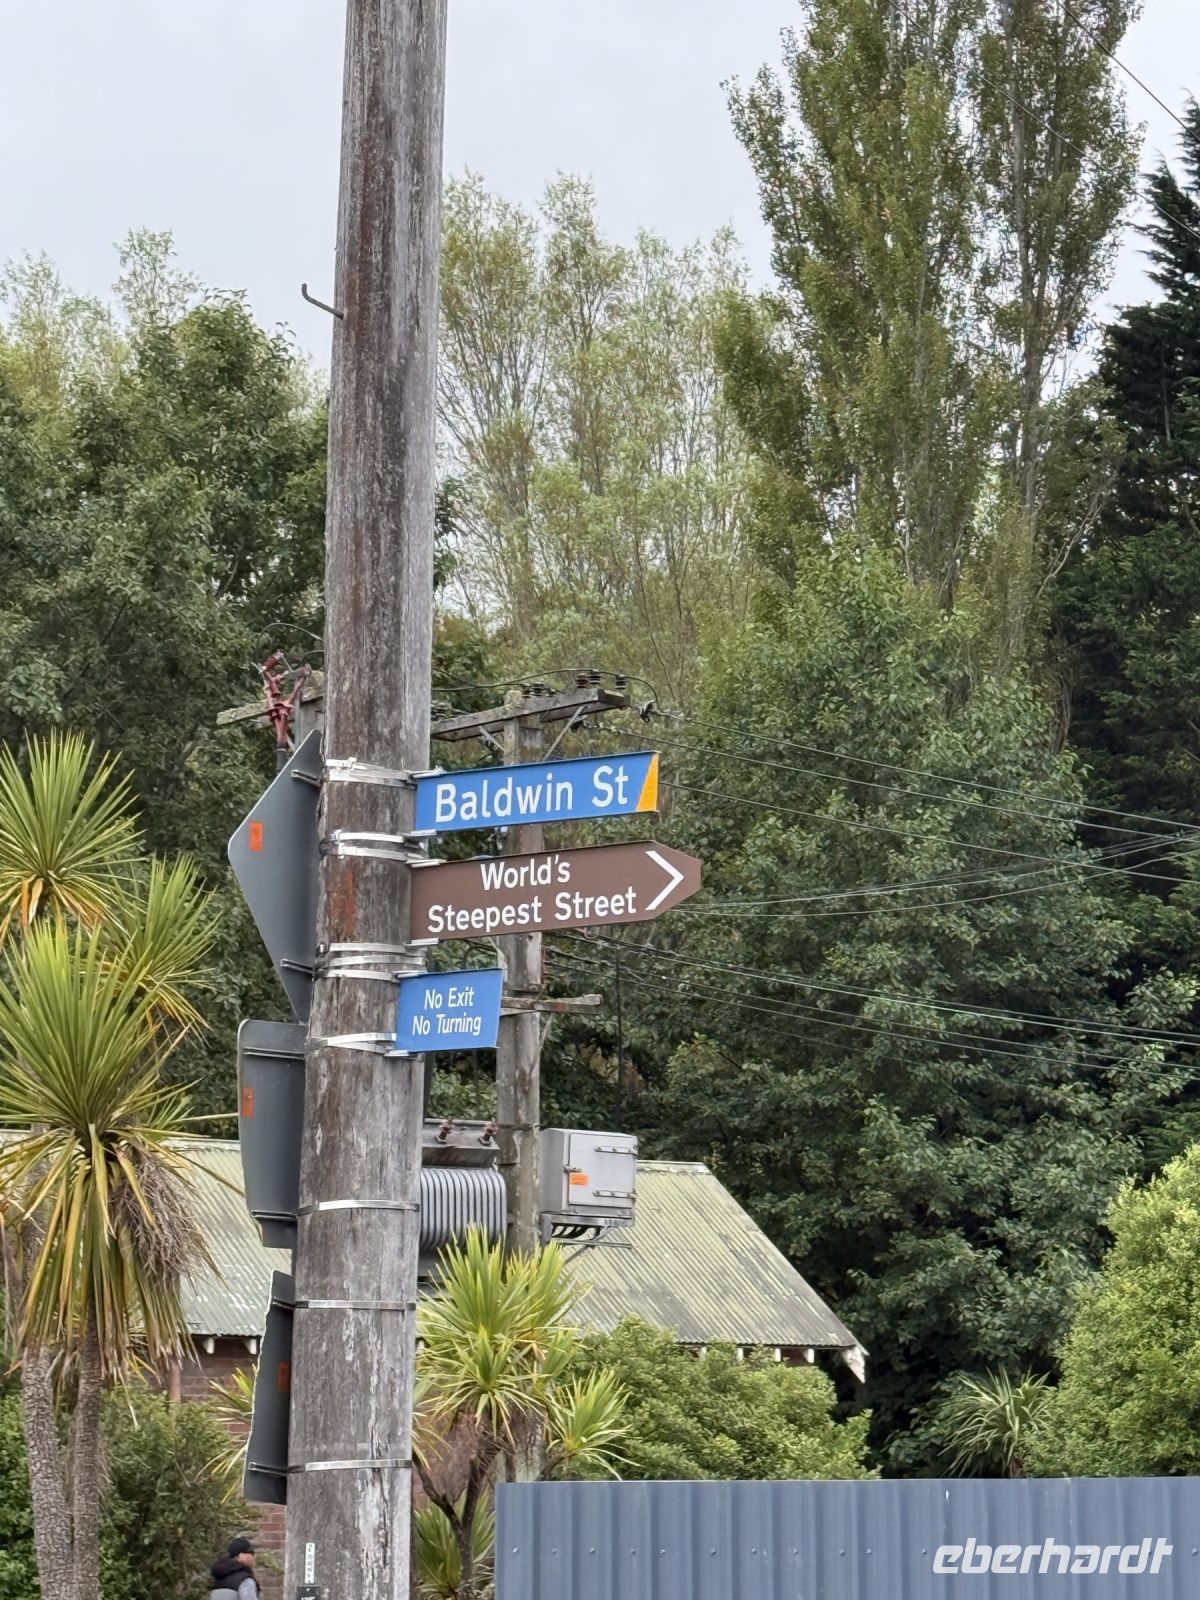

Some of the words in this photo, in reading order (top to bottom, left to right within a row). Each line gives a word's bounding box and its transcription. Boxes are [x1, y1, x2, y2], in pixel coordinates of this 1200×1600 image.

[435, 772, 573, 823] Baldwin
[592, 765, 629, 808] St
[480, 854, 571, 891] World's
[427, 895, 542, 932] Steepest
[554, 886, 637, 921] Street
[424, 988, 443, 1010] No
[448, 986, 475, 1008] Exit
[412, 1015, 431, 1036] No
[436, 1012, 482, 1036] Turning
